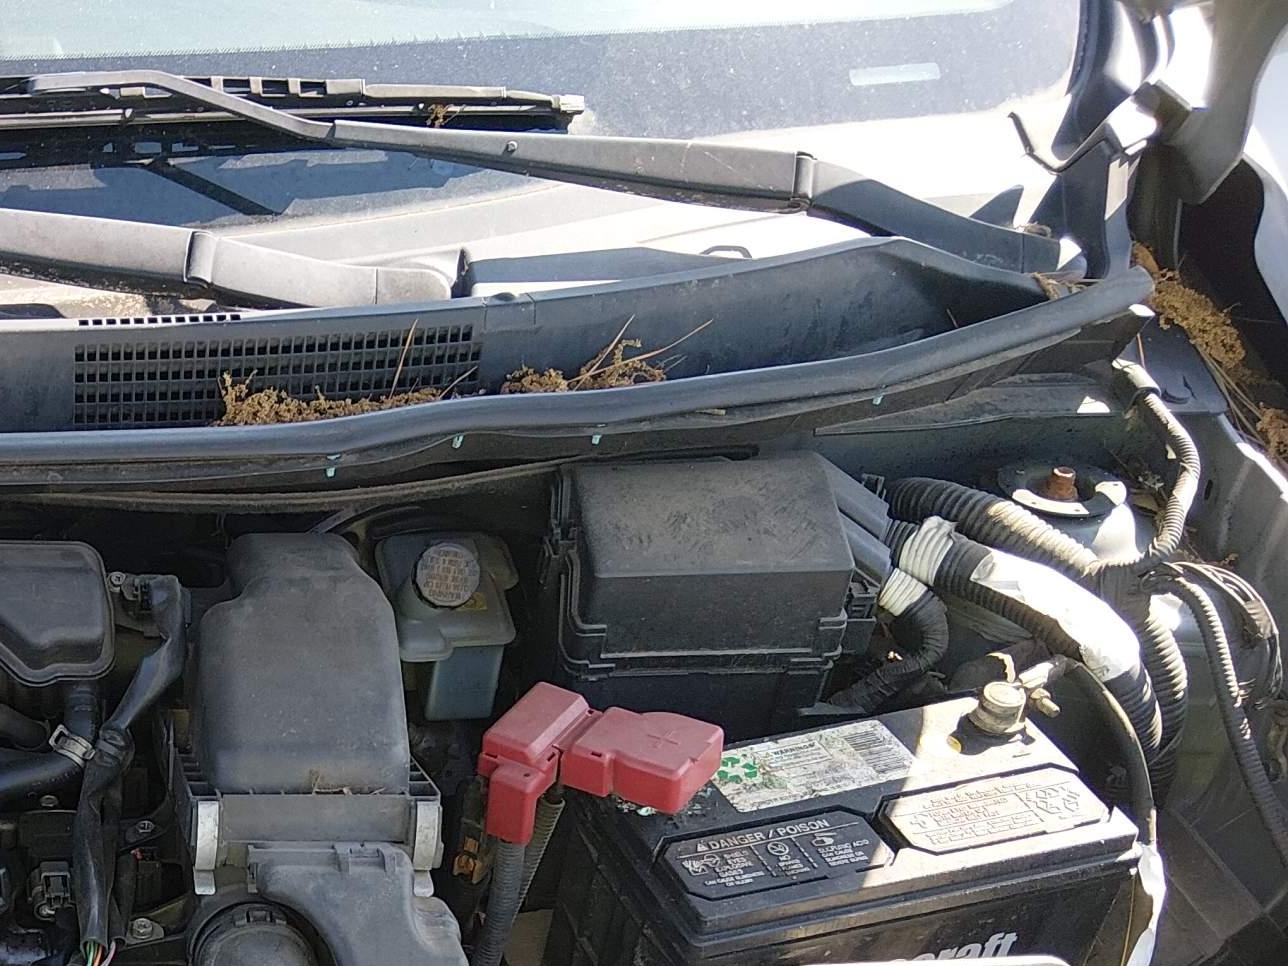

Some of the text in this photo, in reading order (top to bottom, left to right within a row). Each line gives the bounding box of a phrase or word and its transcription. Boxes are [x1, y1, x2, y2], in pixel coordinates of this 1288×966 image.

[709, 819, 831, 850] DANGER / POISON
